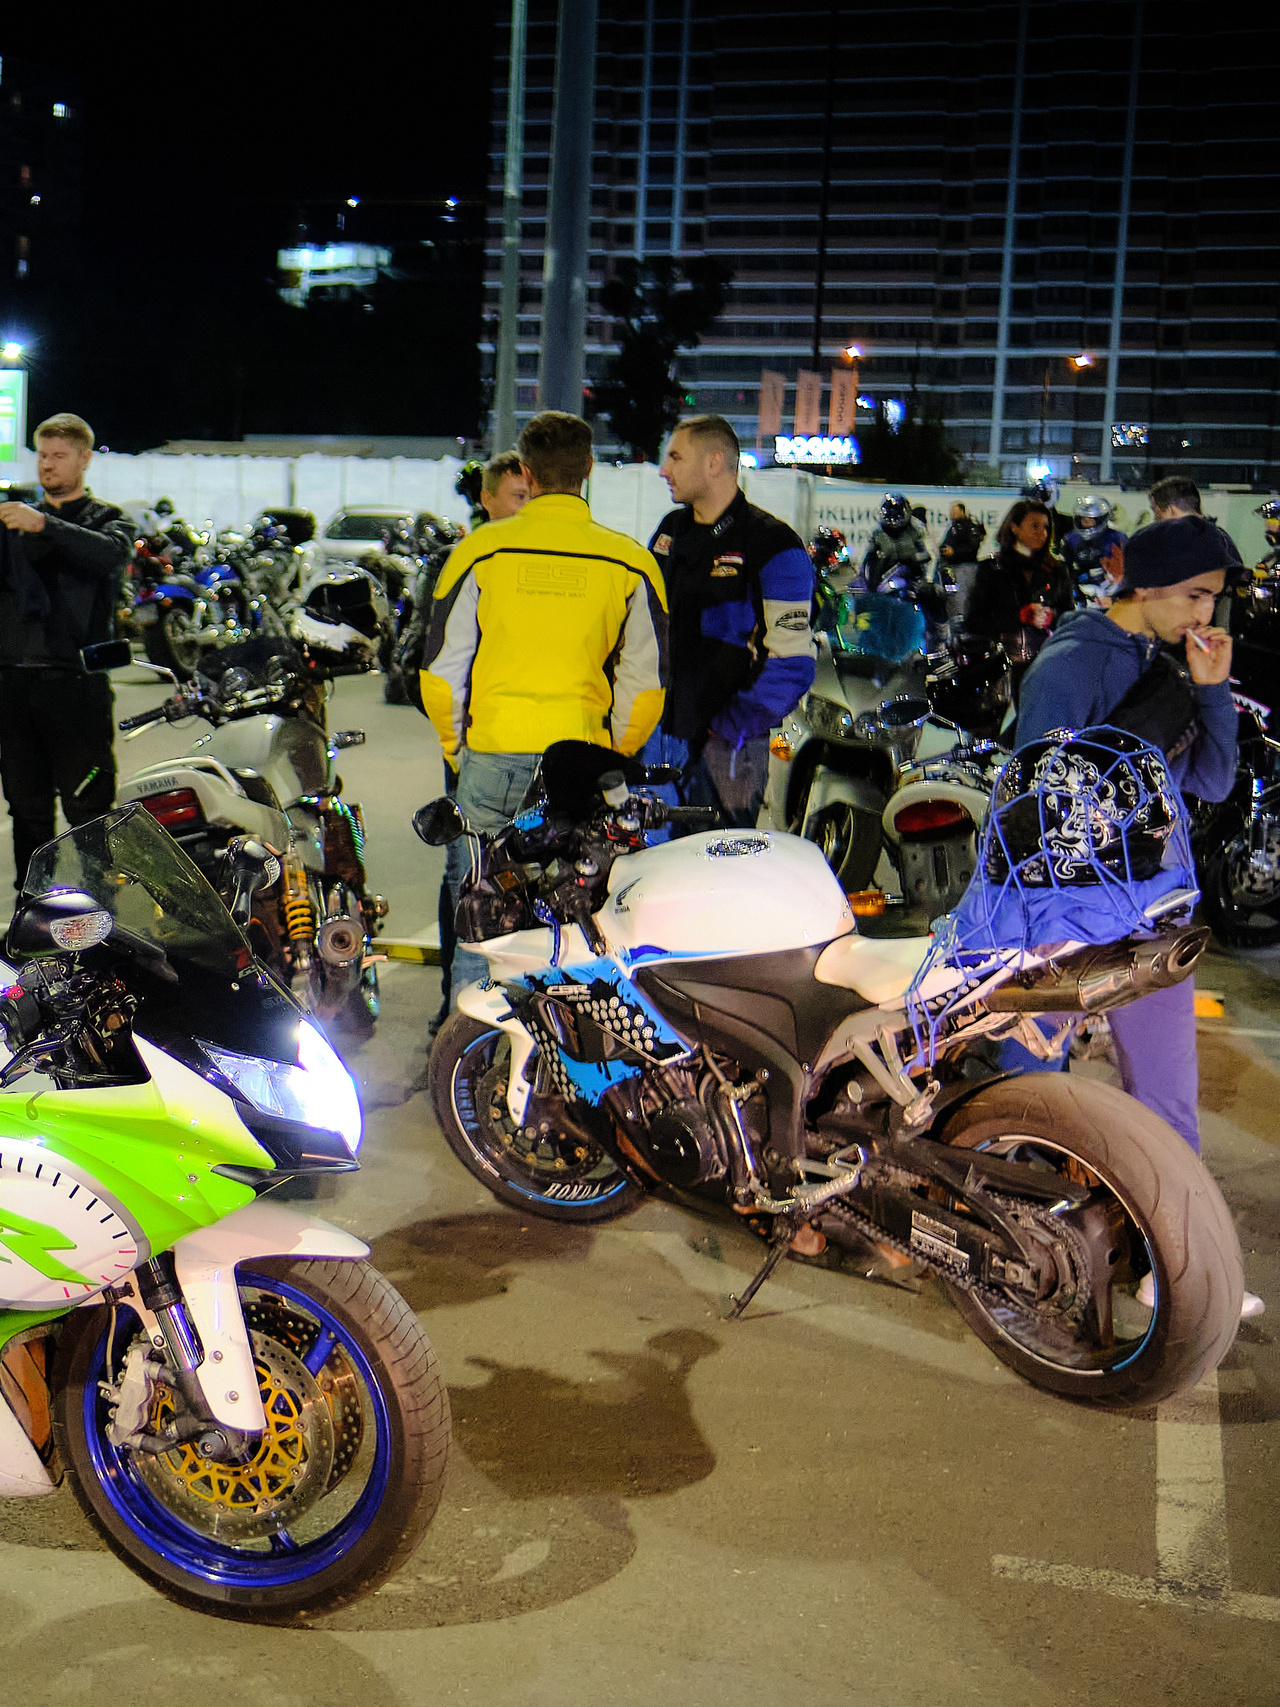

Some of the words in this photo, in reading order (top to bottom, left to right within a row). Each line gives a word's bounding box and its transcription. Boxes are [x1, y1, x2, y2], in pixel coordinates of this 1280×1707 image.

[137, 776, 179, 793] YAMAHA
[546, 984, 592, 996] CBR
[542, 1182, 602, 1200] HONDA
